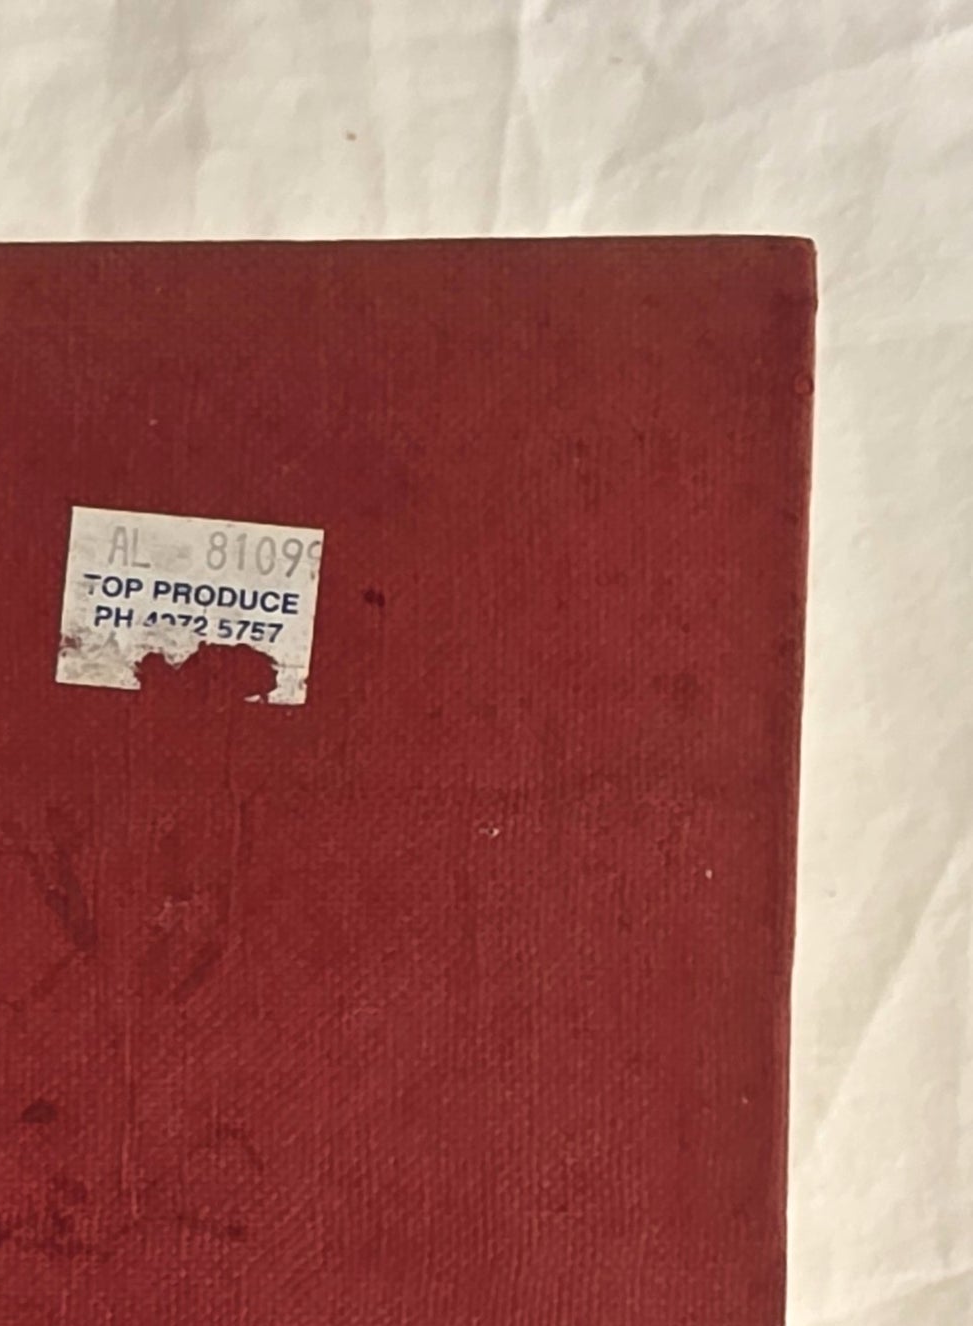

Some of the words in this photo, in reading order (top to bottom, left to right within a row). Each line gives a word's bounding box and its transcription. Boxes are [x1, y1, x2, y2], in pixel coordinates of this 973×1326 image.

[107, 526, 151, 569] AL
[83, 573, 144, 599] TOP
[153, 580, 300, 615] PRODUCE
[94, 606, 134, 628] PH
[217, 619, 284, 643] 5757
